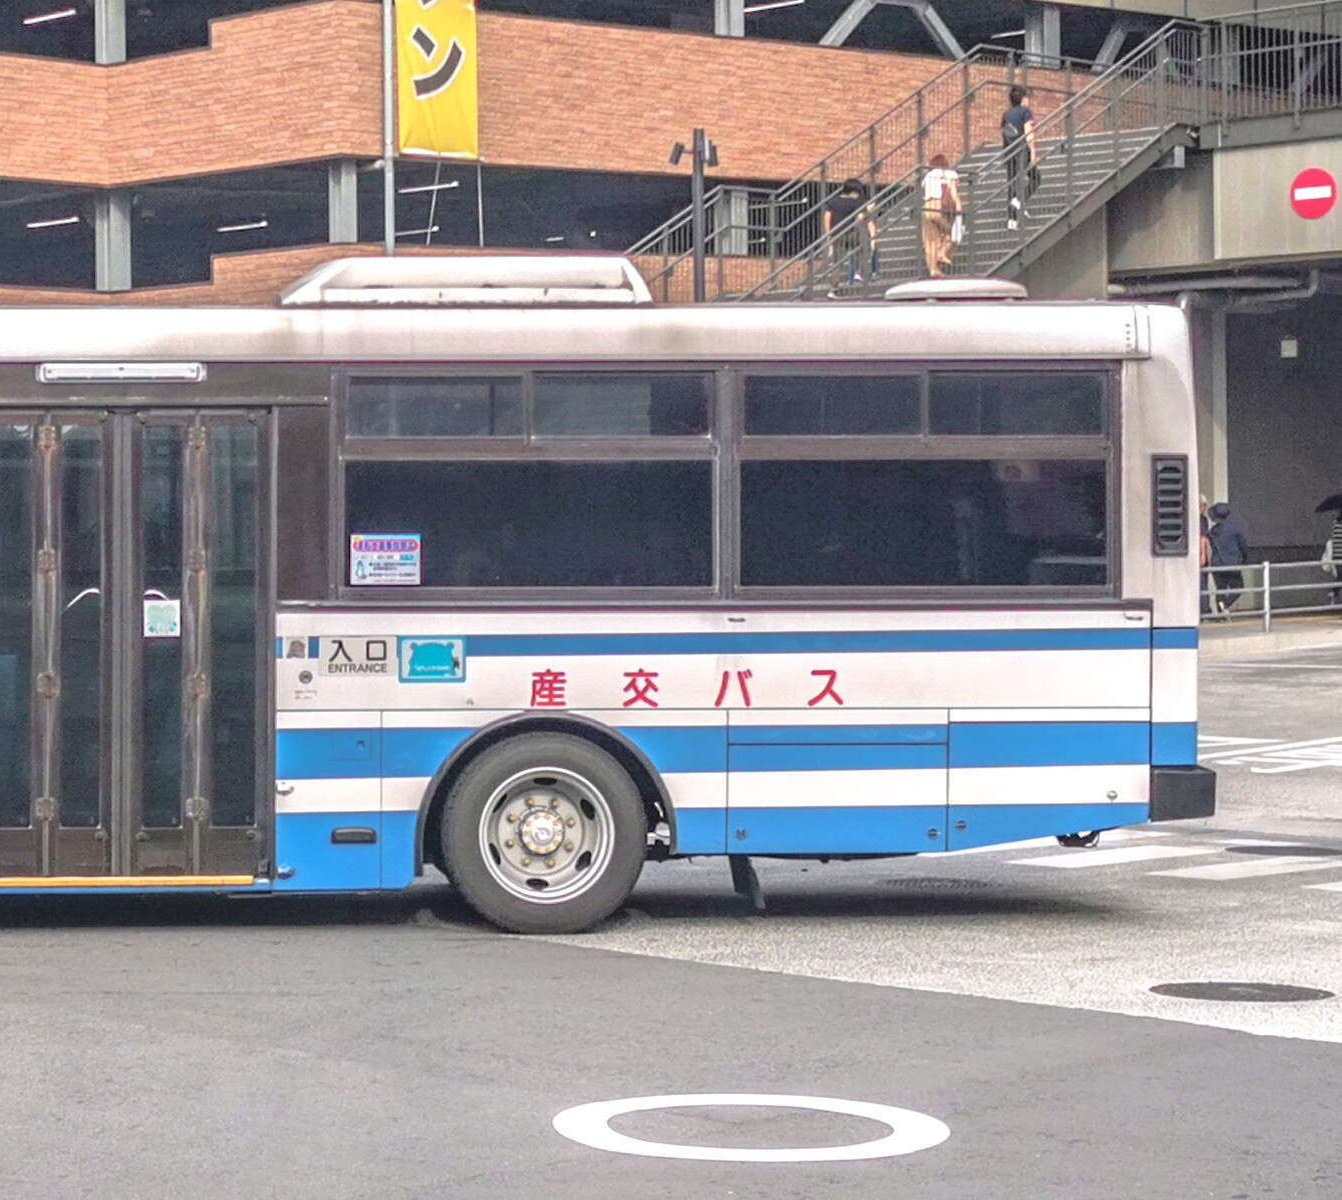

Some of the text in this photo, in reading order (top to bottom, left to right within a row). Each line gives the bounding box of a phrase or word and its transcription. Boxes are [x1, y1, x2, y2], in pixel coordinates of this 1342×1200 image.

[411, 0, 466, 99] ン
[329, 640, 387, 662] 入口
[328, 663, 387, 673] ENTRANCE
[530, 668, 844, 707] 産交バス
